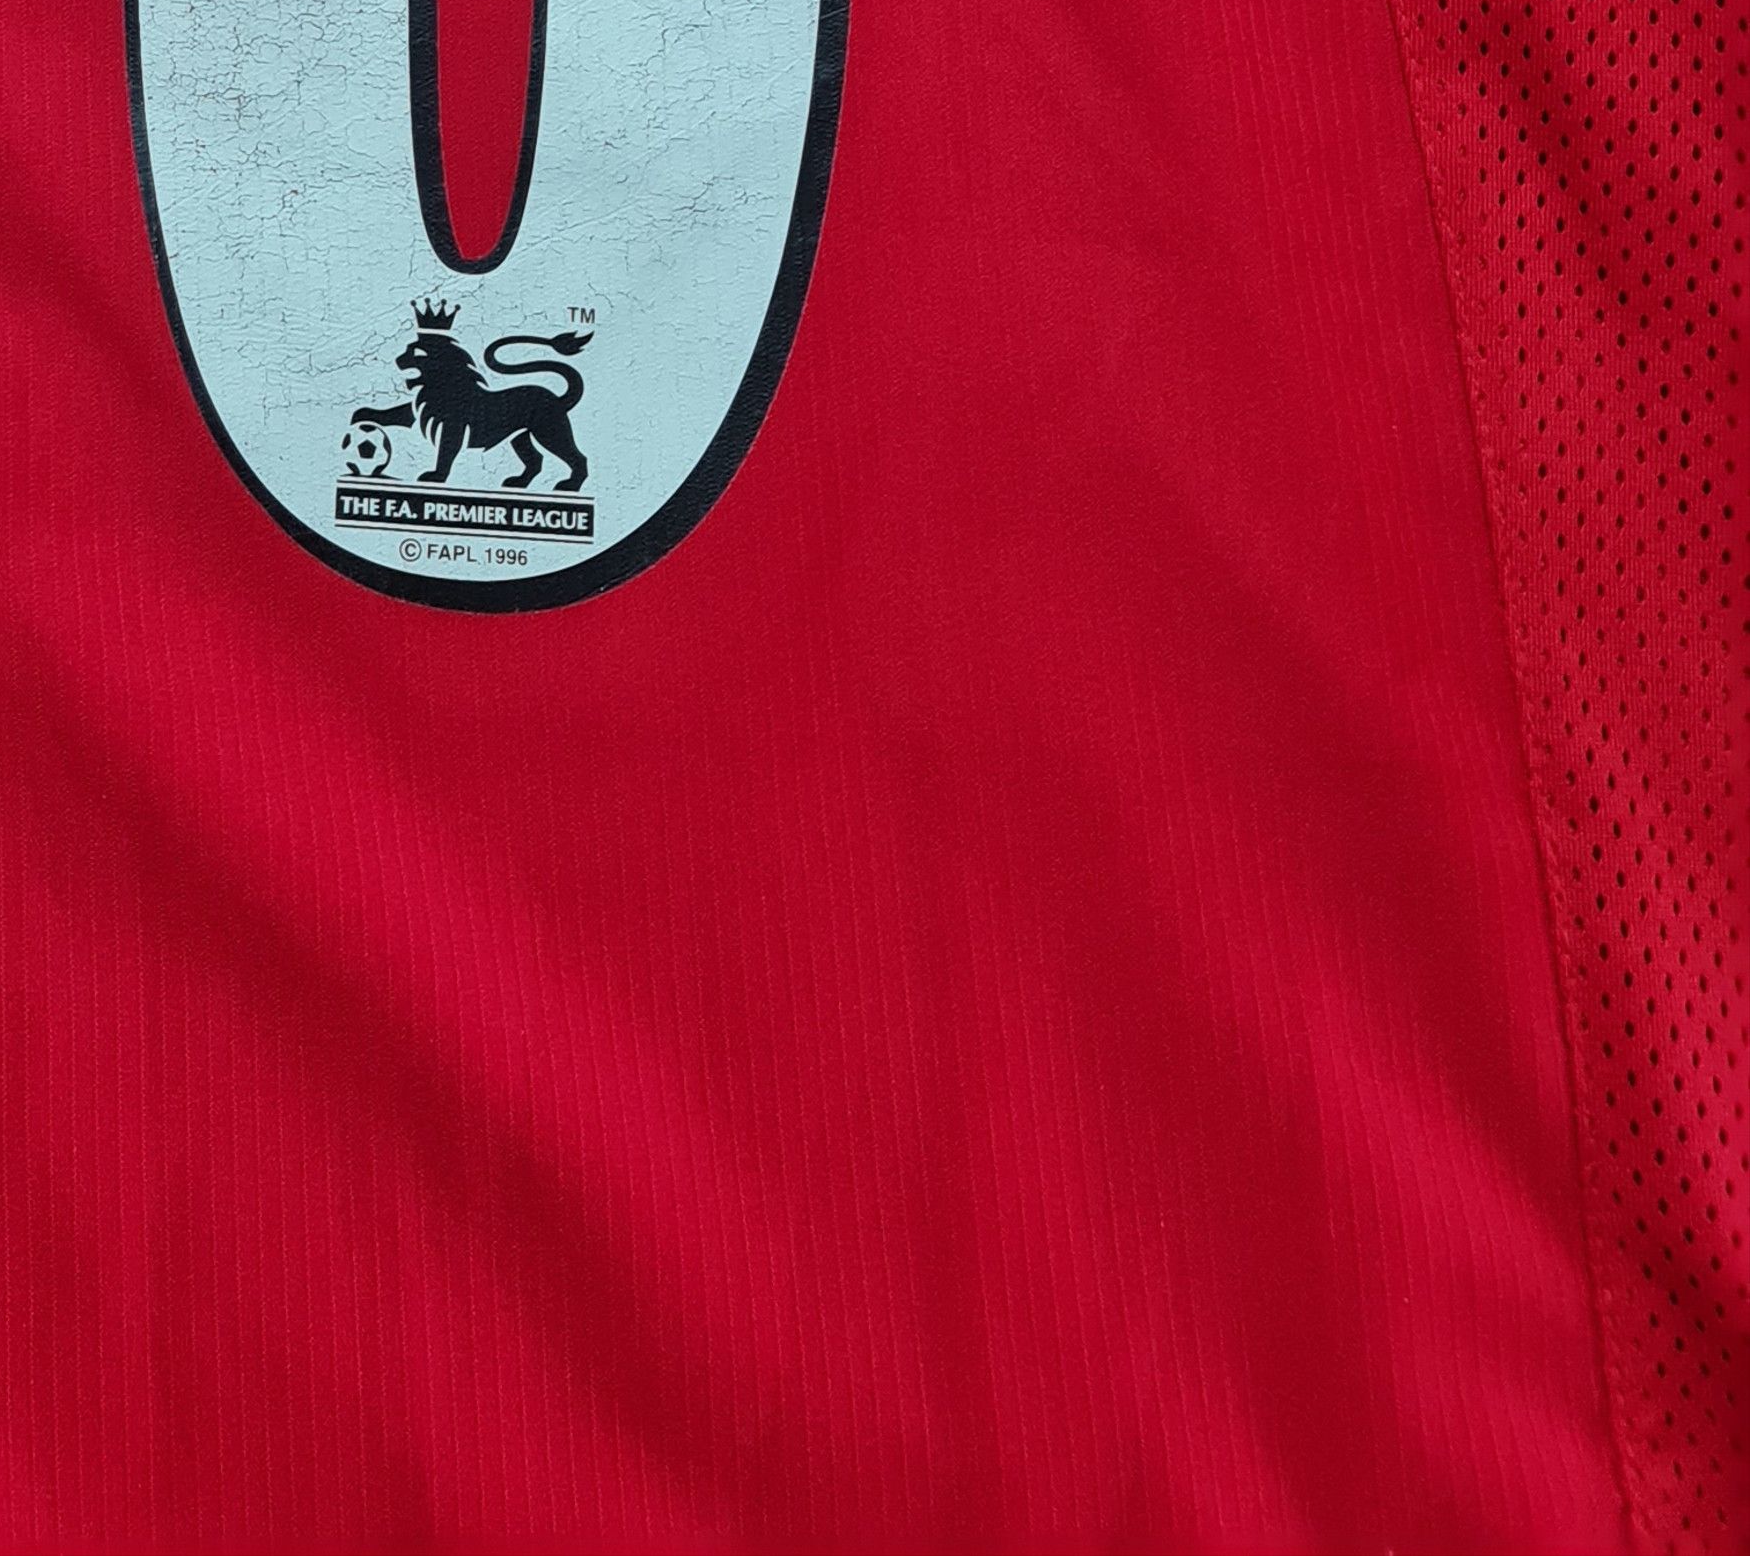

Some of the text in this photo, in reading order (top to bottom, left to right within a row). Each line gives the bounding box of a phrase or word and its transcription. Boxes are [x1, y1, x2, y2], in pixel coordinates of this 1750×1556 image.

[567, 307, 596, 324] TM
[340, 496, 589, 530] THE F.A. PREMIER LEAGUE
[427, 544, 476, 562] FAPL
[484, 548, 528, 565] 1996
